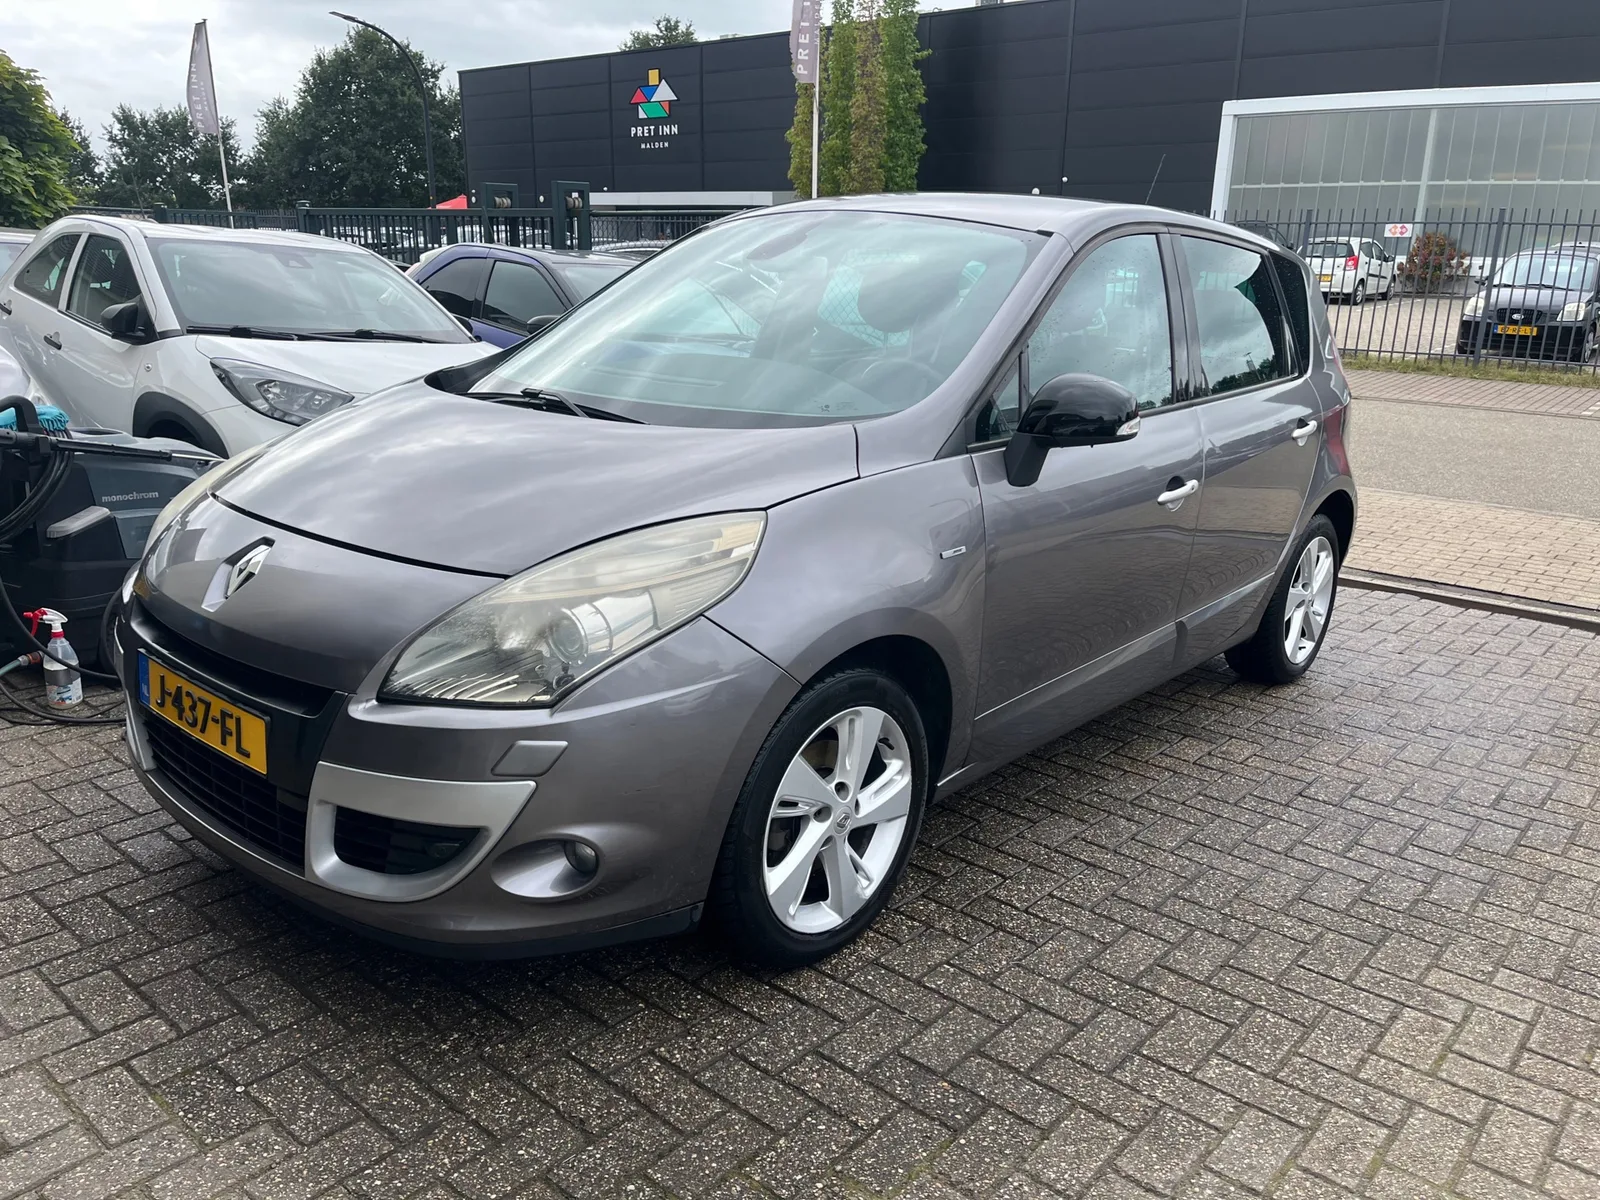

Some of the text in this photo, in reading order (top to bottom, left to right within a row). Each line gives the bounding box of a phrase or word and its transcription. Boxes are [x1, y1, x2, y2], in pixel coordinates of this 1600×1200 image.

[191, 63, 205, 128] PRET INN
[630, 124, 678, 137] PRET INN
[640, 141, 669, 149] MALDEN
[101, 491, 159, 502] monochrom
[155, 673, 251, 759] J-437-FL
